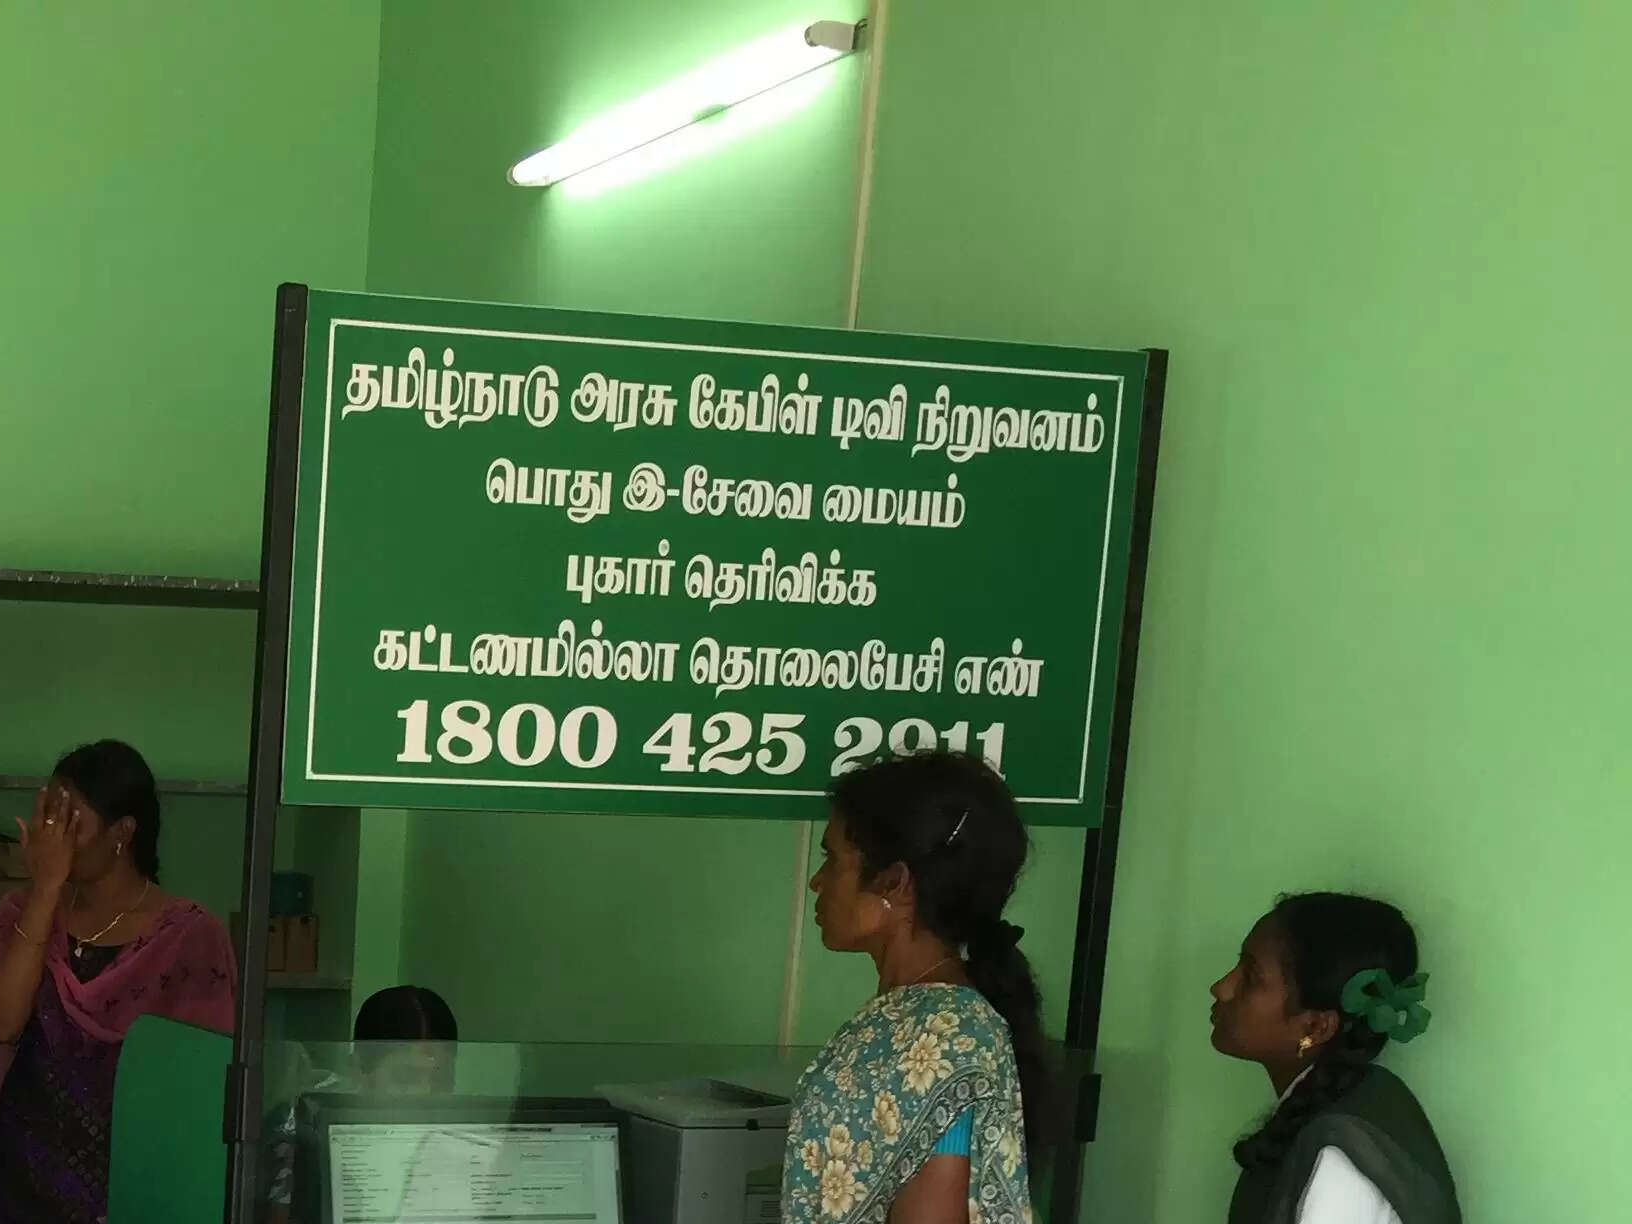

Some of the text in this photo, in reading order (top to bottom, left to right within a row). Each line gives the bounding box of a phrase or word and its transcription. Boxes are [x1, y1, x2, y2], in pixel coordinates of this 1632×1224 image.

[342, 347, 1104, 462] தமிழ்நாடு அரசு கேபிள் டிவி நிறுவனம்
[486, 458, 965, 527] பொது இ-சேவை மையம்
[567, 540, 876, 611] புகார் தெரிவிக்க
[374, 619, 1044, 698] கட்டணமில்லா தொலைபேசி எண்
[397, 700, 617, 768] 1800
[643, 712, 805, 774] 425
